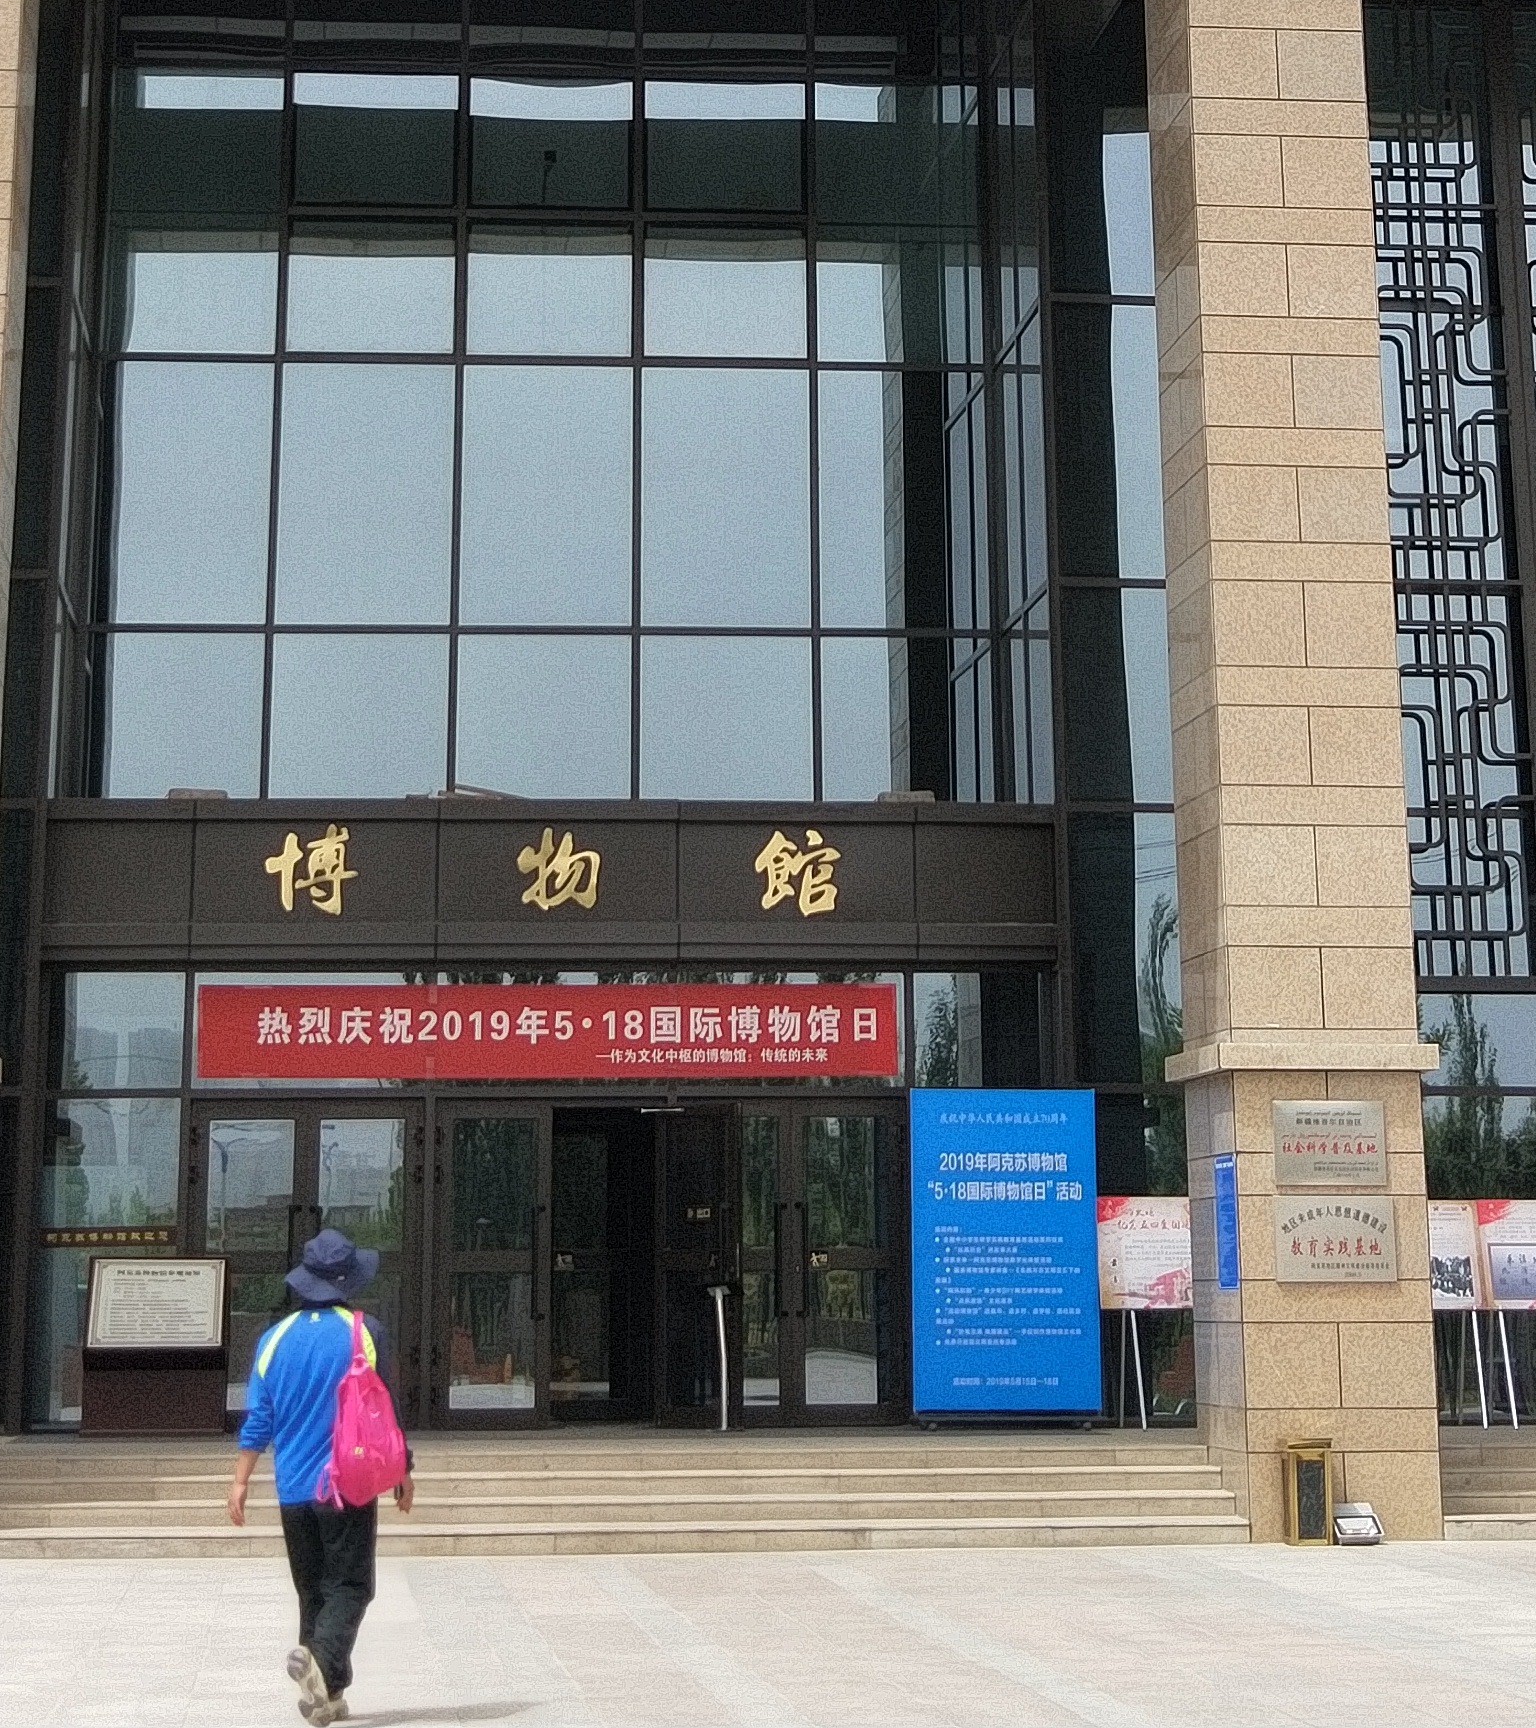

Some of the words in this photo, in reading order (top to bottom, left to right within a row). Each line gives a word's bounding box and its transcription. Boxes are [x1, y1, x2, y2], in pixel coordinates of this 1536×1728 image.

[265, 823, 842, 916] 博物館
[256, 1005, 878, 1045] 热烈庆祝2019年5·18国际博物馆日
[1282, 1141, 1378, 1154] 社会科学普及基地
[939, 1152, 1068, 1172] 2019年阿克苏博物馆
[1291, 1236, 1382, 1257] 教育实践基地
